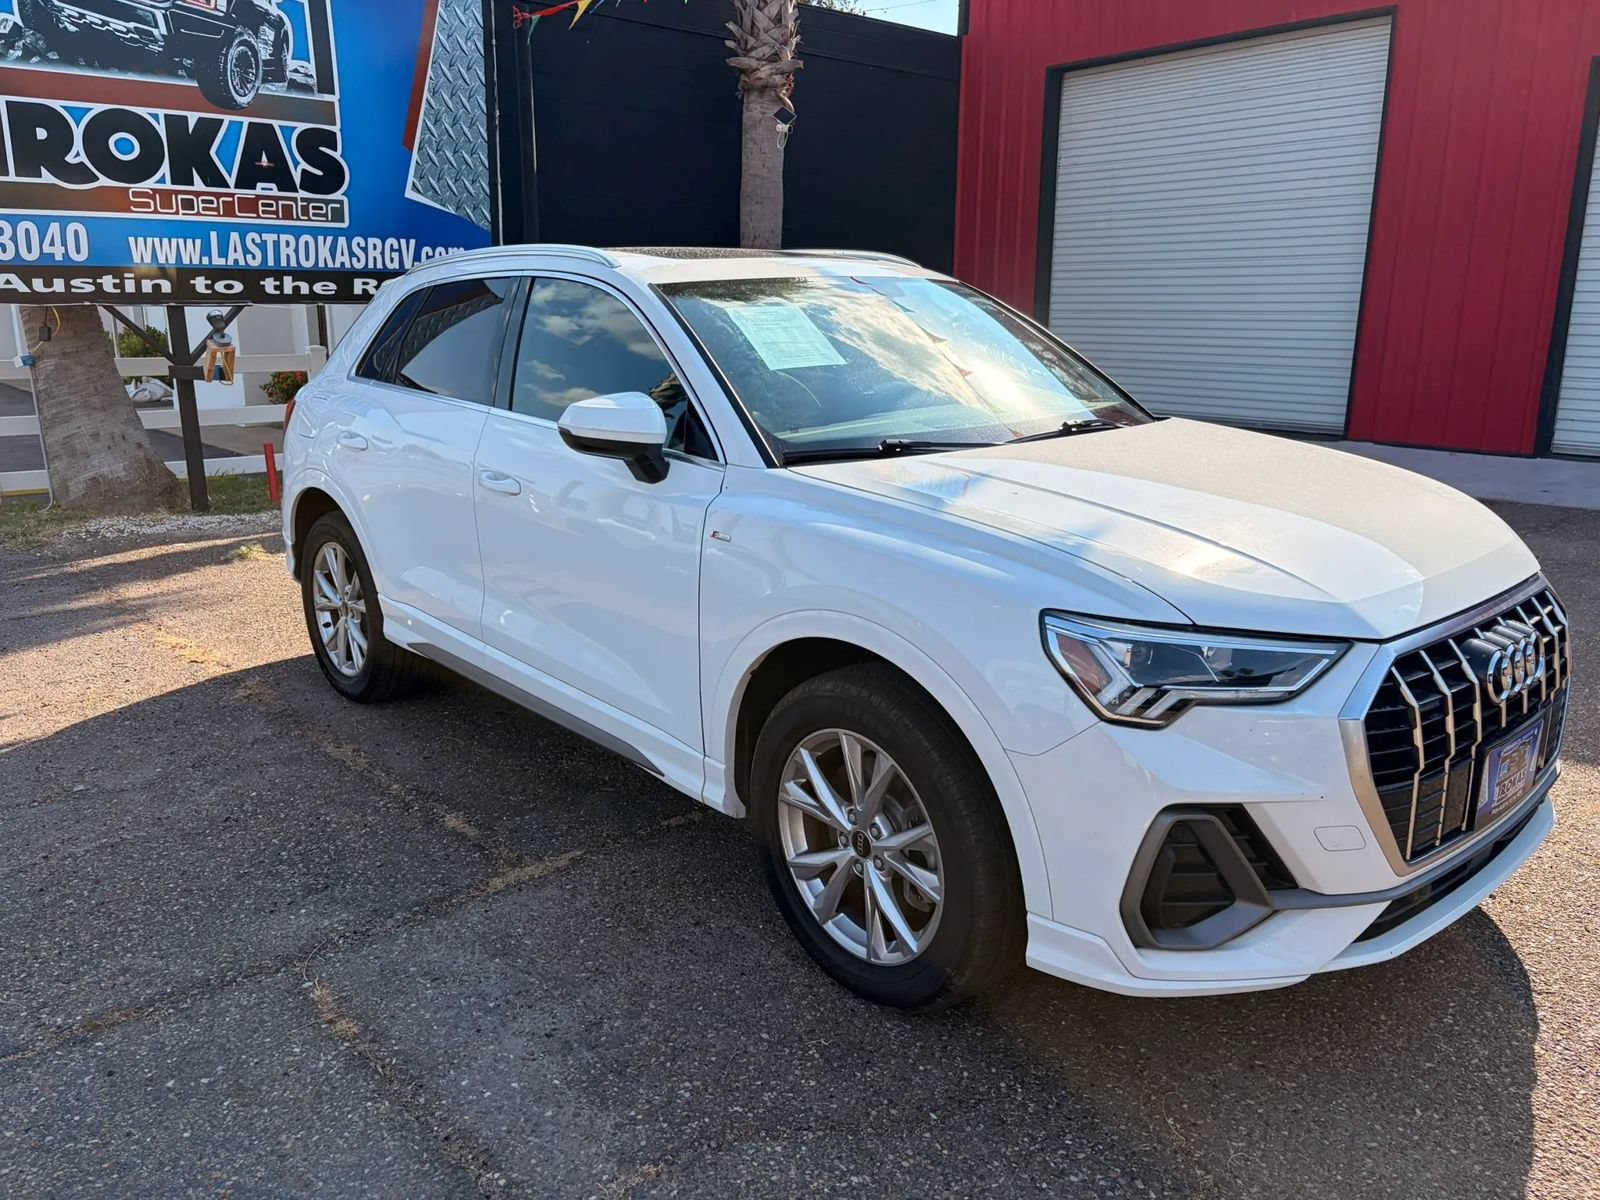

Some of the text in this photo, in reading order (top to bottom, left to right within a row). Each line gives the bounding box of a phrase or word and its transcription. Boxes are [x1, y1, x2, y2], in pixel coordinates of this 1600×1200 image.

[0, 100, 347, 195] ROKAS
[129, 188, 341, 221] SuperCenter
[0, 220, 465, 270] 3040 www.LASTROKASRGV.c
[0, 273, 172, 294] Austin
[190, 276, 244, 294] to
[260, 276, 338, 295] the
